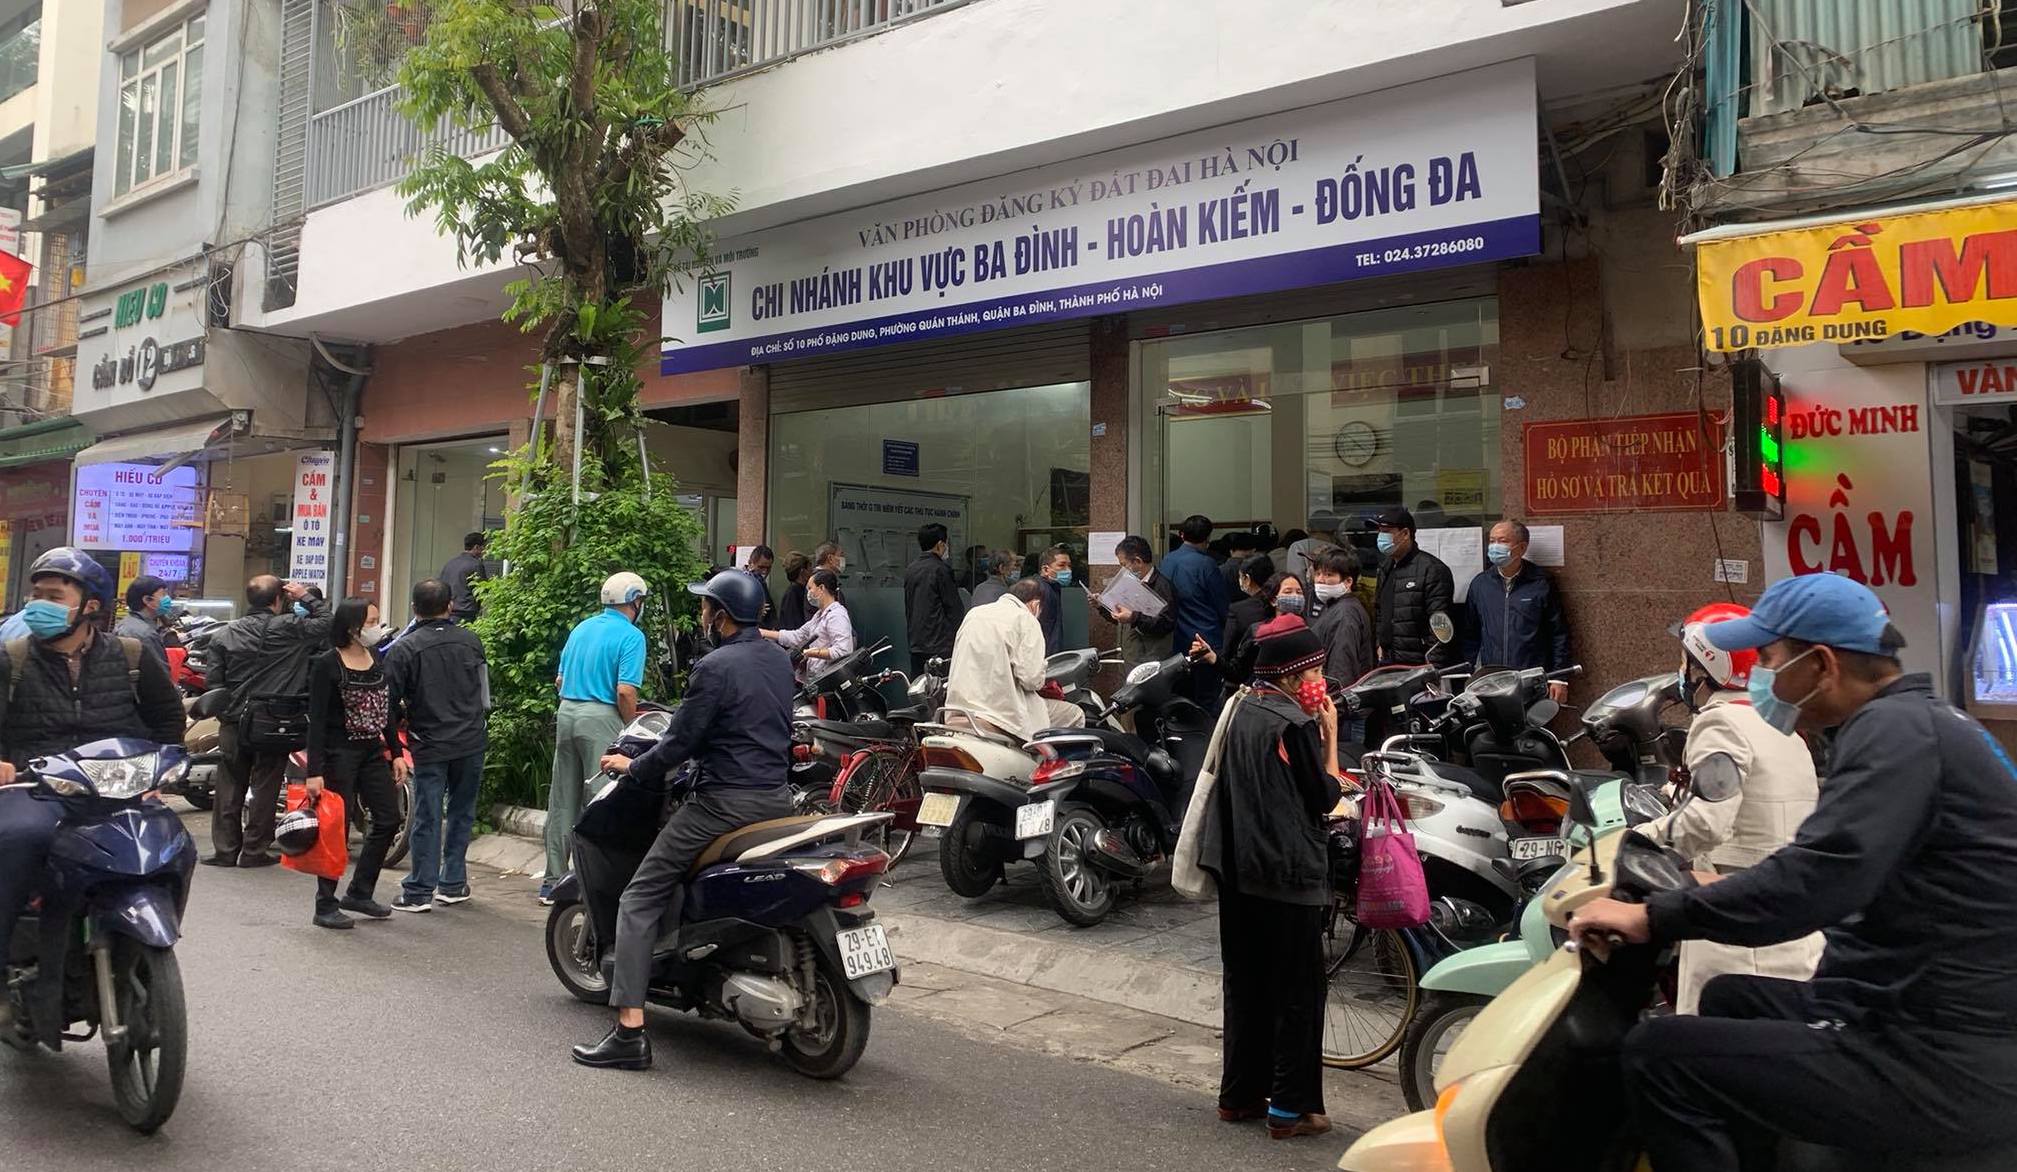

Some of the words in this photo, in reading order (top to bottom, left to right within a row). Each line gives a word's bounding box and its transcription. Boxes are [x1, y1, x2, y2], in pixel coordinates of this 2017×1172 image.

[857, 221, 898, 248] VĂN
[903, 207, 975, 241] PHÒNG
[981, 193, 1042, 221] ĐĂNG
[1050, 179, 1083, 210] KÝ
[1090, 170, 1141, 201] ĐẤT
[1146, 162, 1192, 191] ĐAI
[1200, 146, 1239, 180] HÀ
[1247, 138, 1300, 172] NỘI
[752, 282, 784, 321] CHI
[790, 266, 862, 315] NHÁNH
[868, 258, 913, 301] KHU
[920, 246, 965, 297] VỰC
[973, 240, 1007, 283] BA
[1015, 224, 1079, 275] ĐÌNH
[1107, 202, 1188, 260] HOÀN
[1198, 178, 1280, 245] KIẾM
[1315, 155, 1415, 225] ĐỐNG
[1428, 151, 1482, 205] ĐA
[1356, 251, 1381, 267] TEL:
[1384, 237, 1484, 263] 024.37286080
[751, 345, 764, 357] ĐỊA
[766, 341, 782, 354] CHỈ:
[783, 338, 794, 351] SỐ
[796, 340, 805, 350] 10
[806, 334, 824, 349] PHỐ
[826, 332, 850, 347] ĐẶNG
[851, 328, 877, 341] DUNG,
[880, 321, 916, 337] PHƯỜNG
[918, 315, 945, 331] QUÁN
[946, 310, 981, 326] THÁNH,
[983, 304, 1012, 320] QUẬN
[1014, 304, 1027, 316] BA
[1029, 298, 1056, 313] ĐÌNH,
[1060, 293, 1094, 309] THÀNH
[1097, 286, 1121, 303] PHỐ
[1124, 286, 1139, 300] HÀ
[1142, 283, 1163, 301] NỘI
[1711, 325, 1749, 350] 10
[1823, 320, 1888, 340] DUNG
[1790, 405, 1842, 439] ĐỨC
[1848, 404, 1919, 435] MINH
[1548, 433, 1568, 464] BỘ
[1652, 427, 1697, 460] NHẬN
[310, 488, 318, 500] &
[1536, 473, 1557, 500] HỒ
[1561, 475, 1581, 498] SƠ
[1584, 469, 1604, 498] VÀ
[1607, 466, 1636, 497] TRẢ
[1641, 466, 1674, 496] KẾT
[1677, 464, 1711, 500] QUẢ
[1787, 472, 1917, 587] CẦM
[744, 872, 786, 883] LEAD
[845, 927, 881, 953] 29-E1
[847, 947, 891, 975] 949.48
